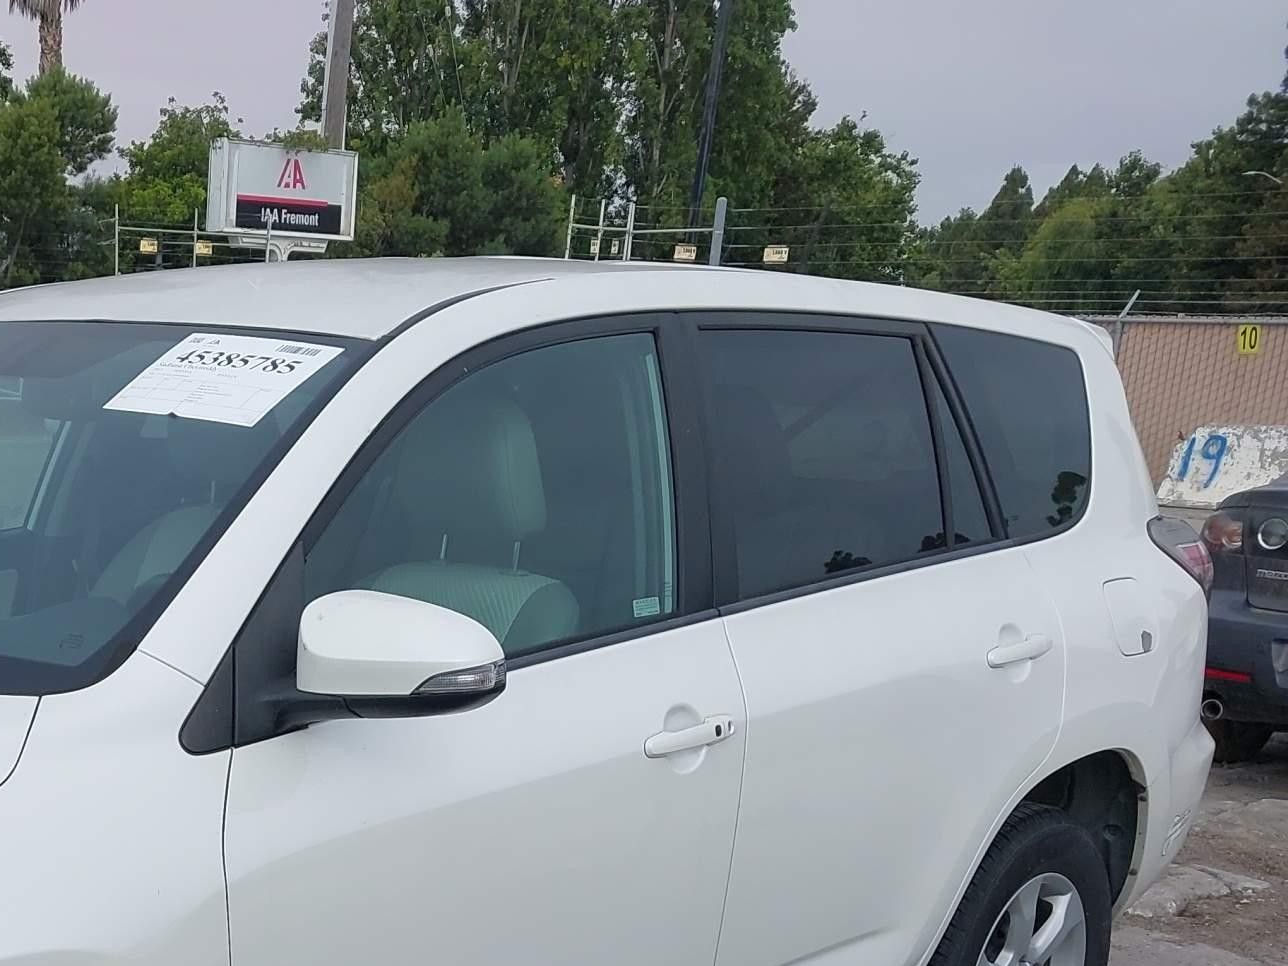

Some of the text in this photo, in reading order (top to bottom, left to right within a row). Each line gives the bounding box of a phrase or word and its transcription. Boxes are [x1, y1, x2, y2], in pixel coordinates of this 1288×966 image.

[261, 207, 319, 226] IAA Fremont
[1240, 326, 1258, 350] 10
[175, 349, 304, 375] 45385785
[1177, 434, 1228, 489] 19
